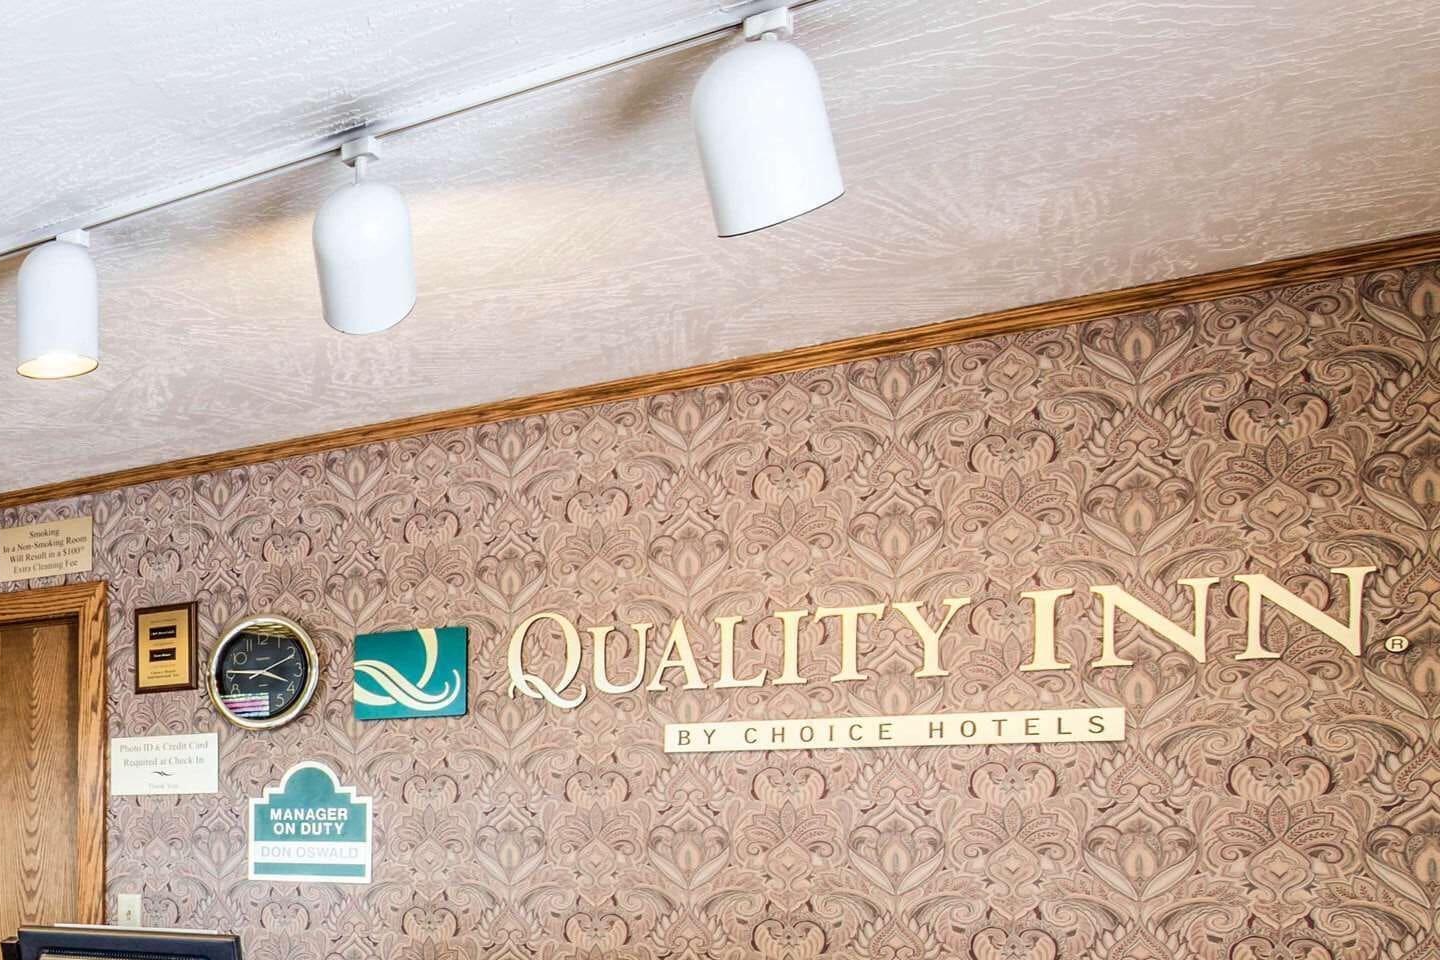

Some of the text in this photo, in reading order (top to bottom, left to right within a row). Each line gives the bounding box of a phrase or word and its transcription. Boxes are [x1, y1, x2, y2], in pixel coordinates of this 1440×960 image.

[29, 527, 60, 538] Smoking
[3, 545, 10, 553] In
[17, 539, 64, 551] Non-Smoking
[65, 536, 87, 545] Room
[9, 555, 24, 563] Will
[25, 551, 47, 561] Result
[13, 566, 31, 574] Extra
[65, 559, 79, 567] Fee
[507, 597, 971, 709] QUALITY
[1019, 565, 1377, 672] INN
[245, 639, 253, 652] 11
[231, 651, 248, 665] 10
[286, 646, 296, 660] 2
[294, 662, 303, 678] 3
[286, 681, 295, 695] 4
[276, 693, 285, 708] 5
[677, 715, 1106, 746] BY CHOICE HOTELS
[119, 743, 142, 753] Photo
[143, 743, 153, 752] ID
[162, 741, 187, 752] Credit
[188, 740, 208, 750] Card
[123, 757, 157, 768] Required
[169, 755, 193, 765] Check
[195, 755, 205, 764] In
[270, 807, 348, 821] MANAGER
[273, 822, 344, 836] ON DUTY
[260, 845, 359, 859] DON OSWALD
